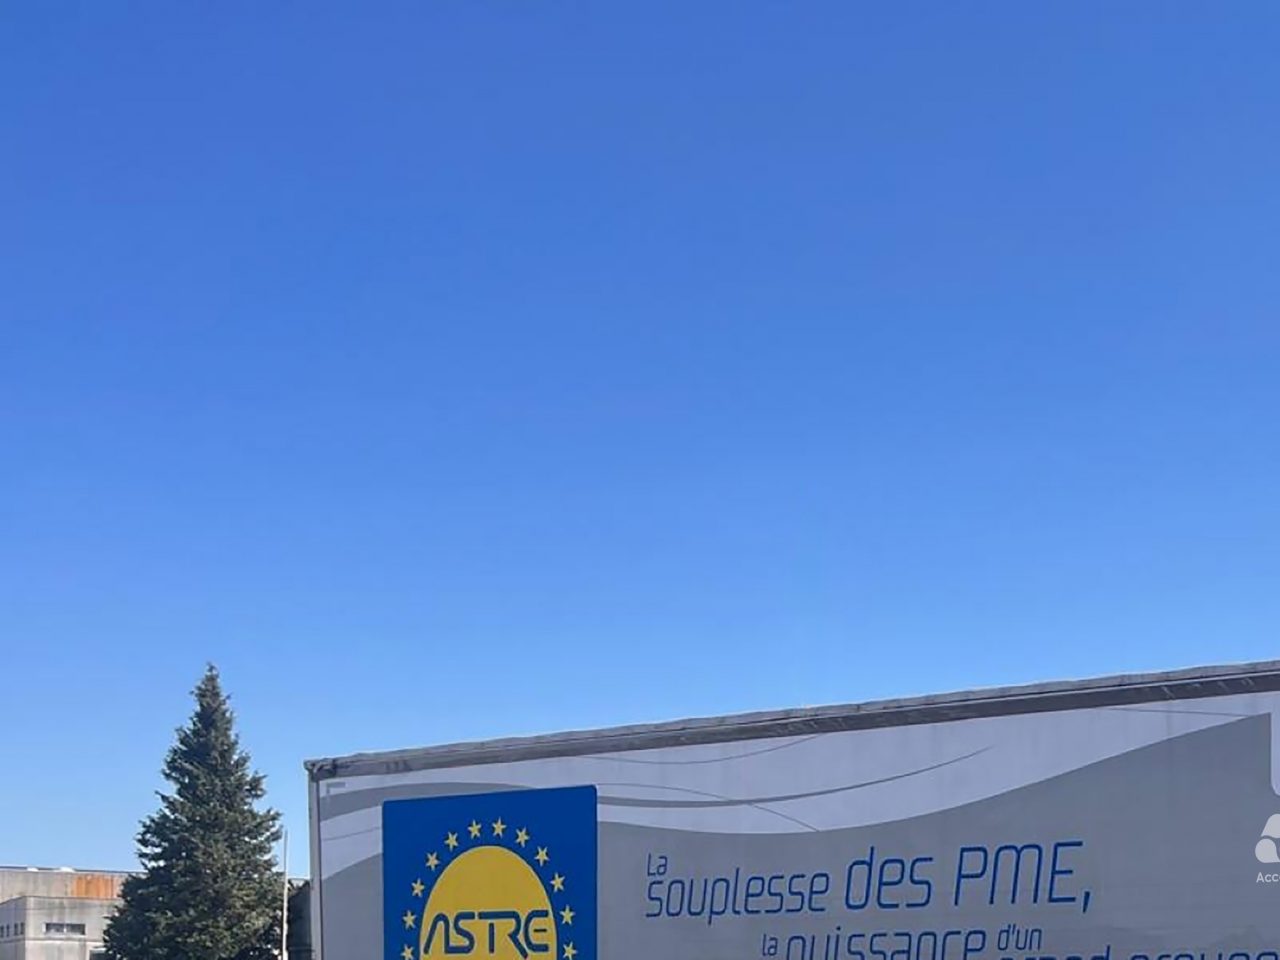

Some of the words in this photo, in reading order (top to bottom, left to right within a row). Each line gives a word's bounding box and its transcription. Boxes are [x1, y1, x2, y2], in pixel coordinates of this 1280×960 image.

[646, 867, 831, 926] souplesse
[844, 845, 935, 912] des
[954, 840, 1092, 914] PME,
[647, 853, 668, 877] La
[423, 910, 550, 960] ASTRE
[761, 933, 779, 958] la
[997, 924, 1042, 952] d'un
